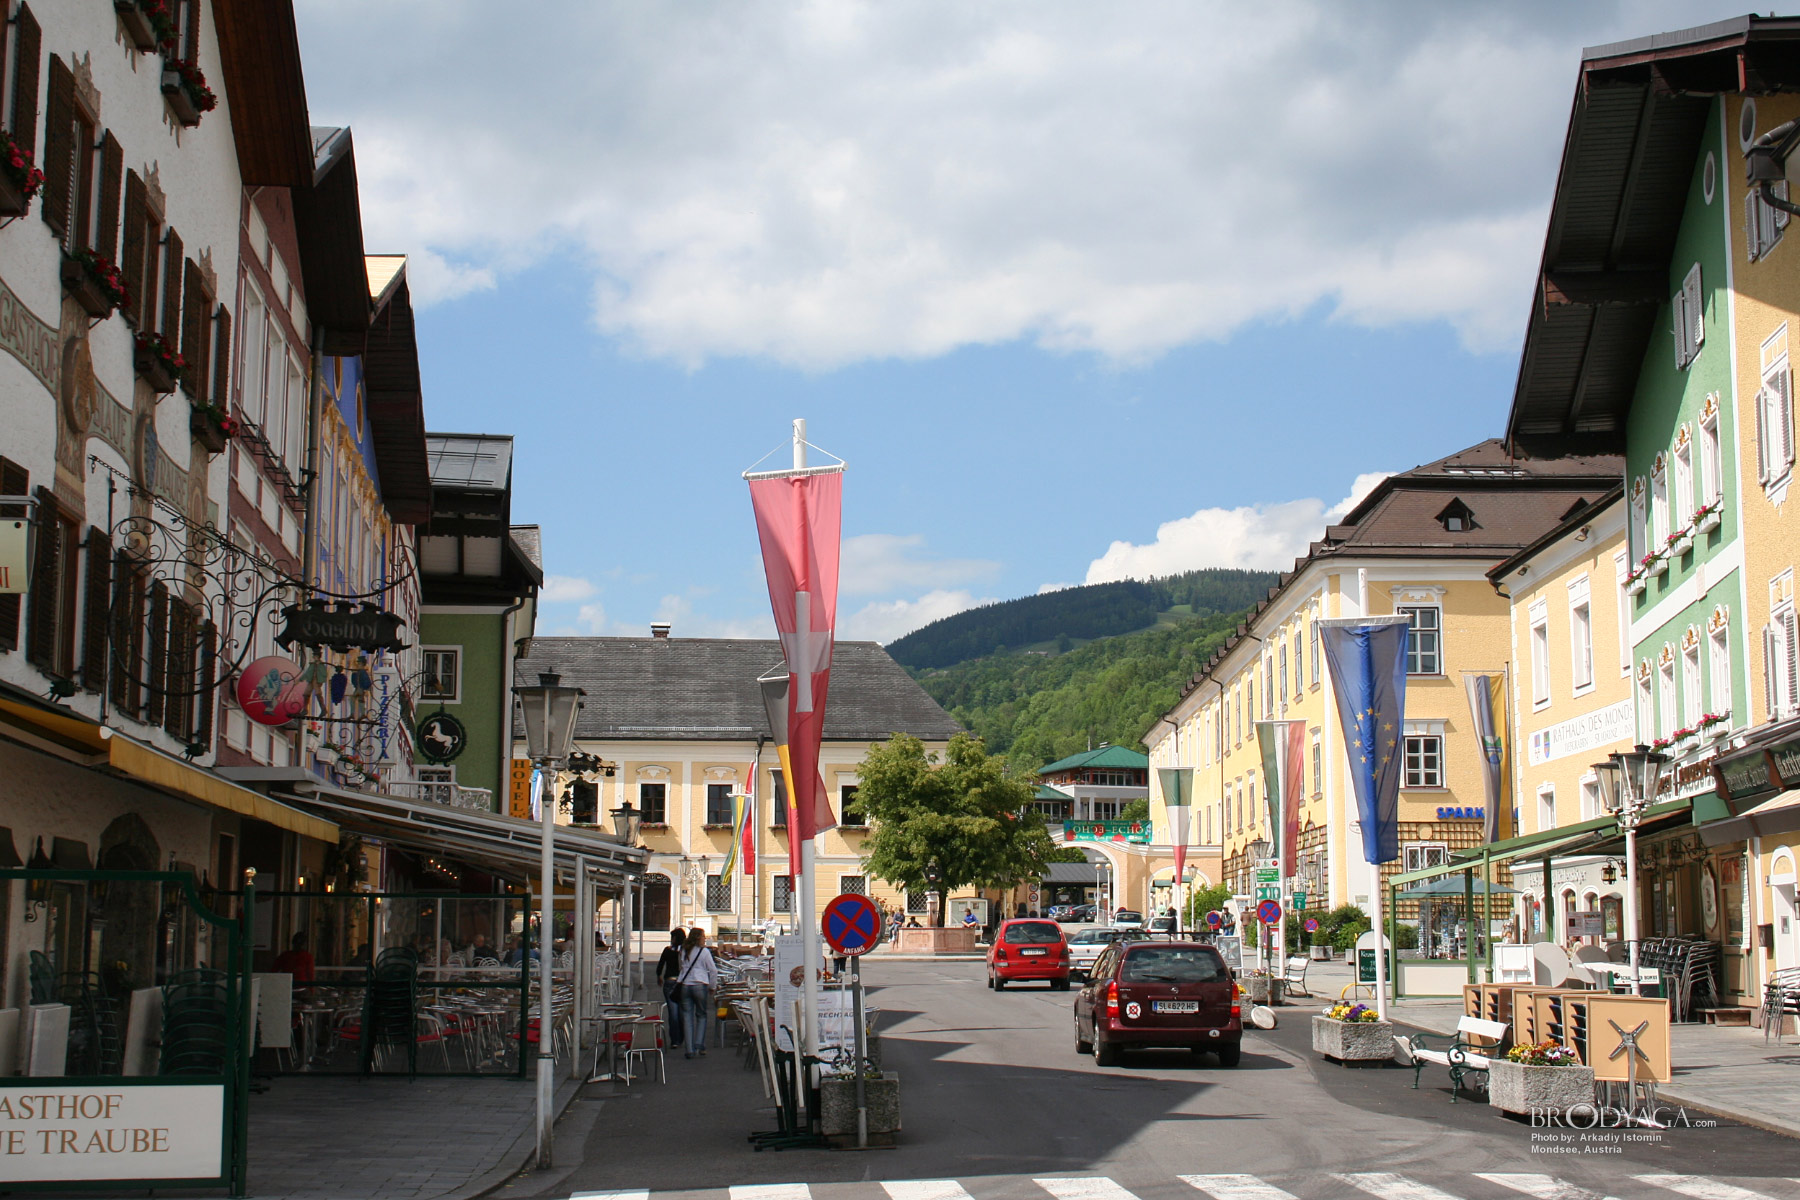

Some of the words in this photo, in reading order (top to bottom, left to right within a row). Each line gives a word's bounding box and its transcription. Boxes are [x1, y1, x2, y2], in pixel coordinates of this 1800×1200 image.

[302, 615, 378, 640] Gasthof
[380, 675, 390, 759] PIZZERIA
[1553, 720, 1586, 744] RATHAUS
[1588, 713, 1602, 732] DES
[513, 760, 525, 812] HOTEL
[843, 945, 865, 954] ANFANG
[37, 1128, 170, 1154] TRAUBE
